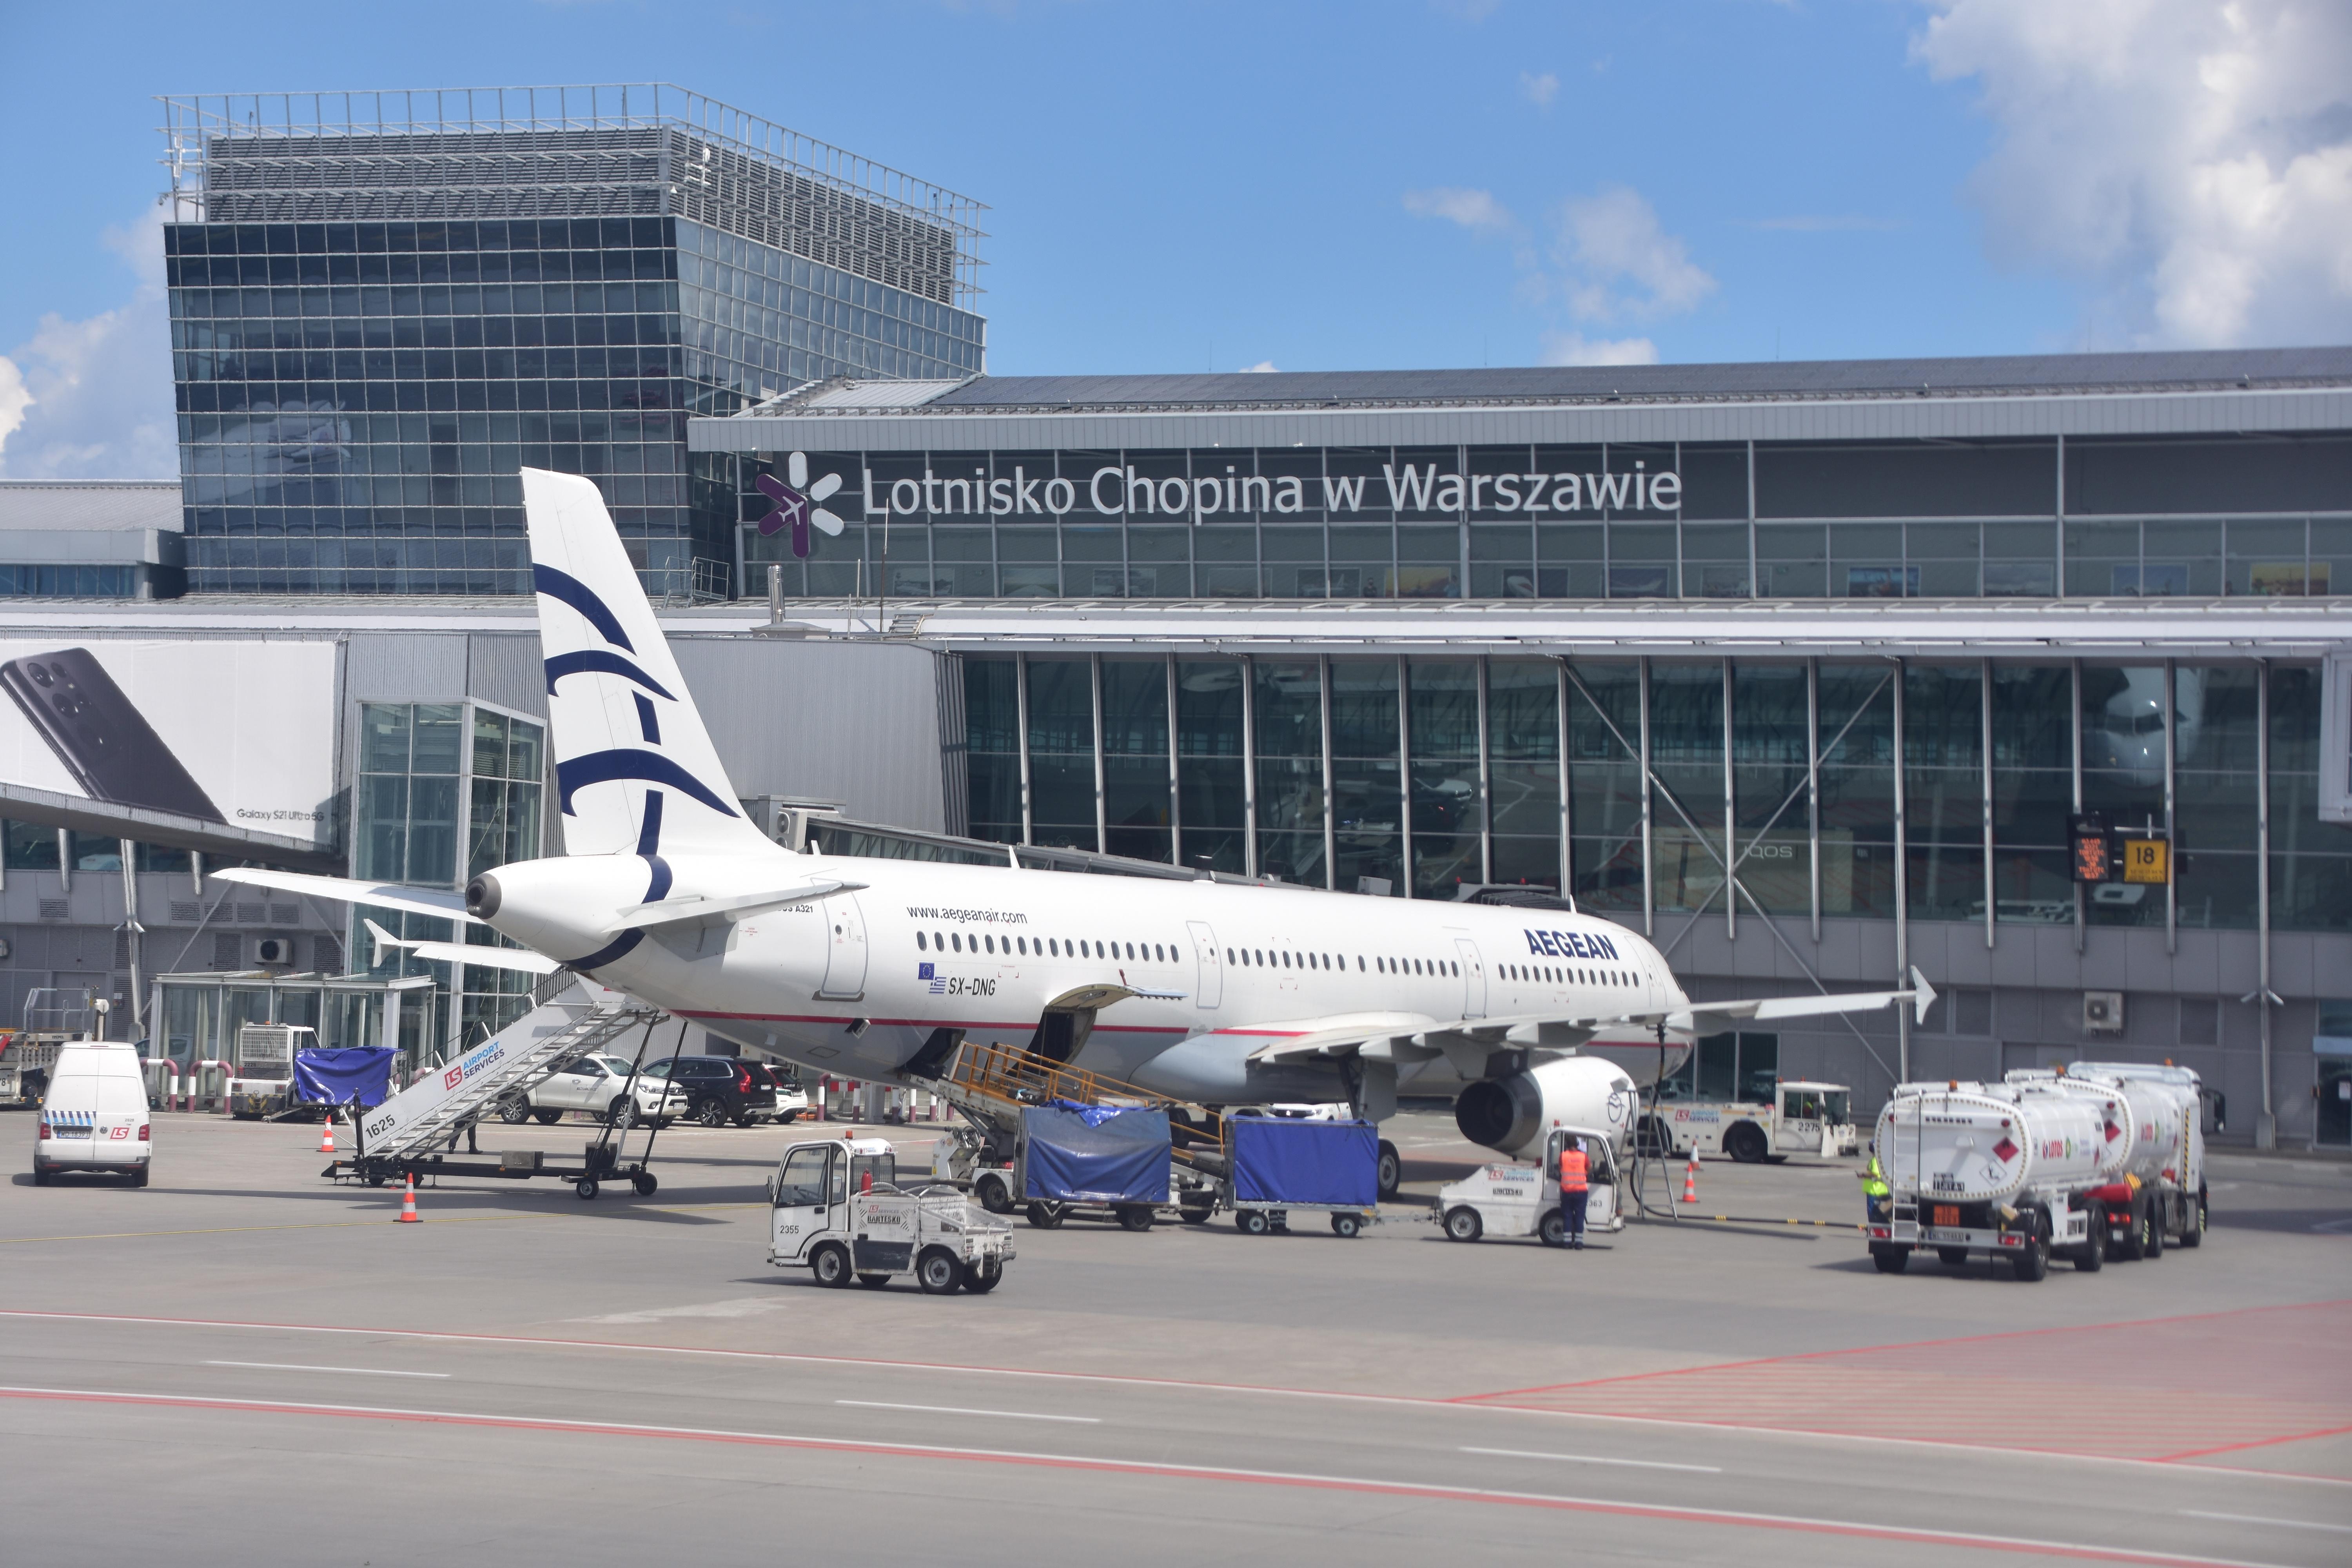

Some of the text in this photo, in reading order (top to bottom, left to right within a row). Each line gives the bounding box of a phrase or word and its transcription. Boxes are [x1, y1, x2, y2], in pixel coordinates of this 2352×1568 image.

[864, 461, 1682, 526] Lotnisko Chopina w Warszawie
[237, 808, 325, 821] Galaxy S21 Ultra 5G
[2137, 847, 2154, 864] 18
[795, 904, 813, 913] A321
[907, 907, 1027, 924] www.aegeanair.com
[1523, 929, 1620, 960] AEGEAN
[949, 977, 995, 995] SX-DNG
[463, 1041, 499, 1071] AIRPORT
[446, 1049, 505, 1088] LS SERVICES
[0, 1078, 5, 1086] 8
[111, 1128, 128, 1138] LS
[1798, 1122, 1820, 1132] 2275
[2049, 1139, 2063, 1158] LOTOS
[780, 1225, 799, 1234] 2355
